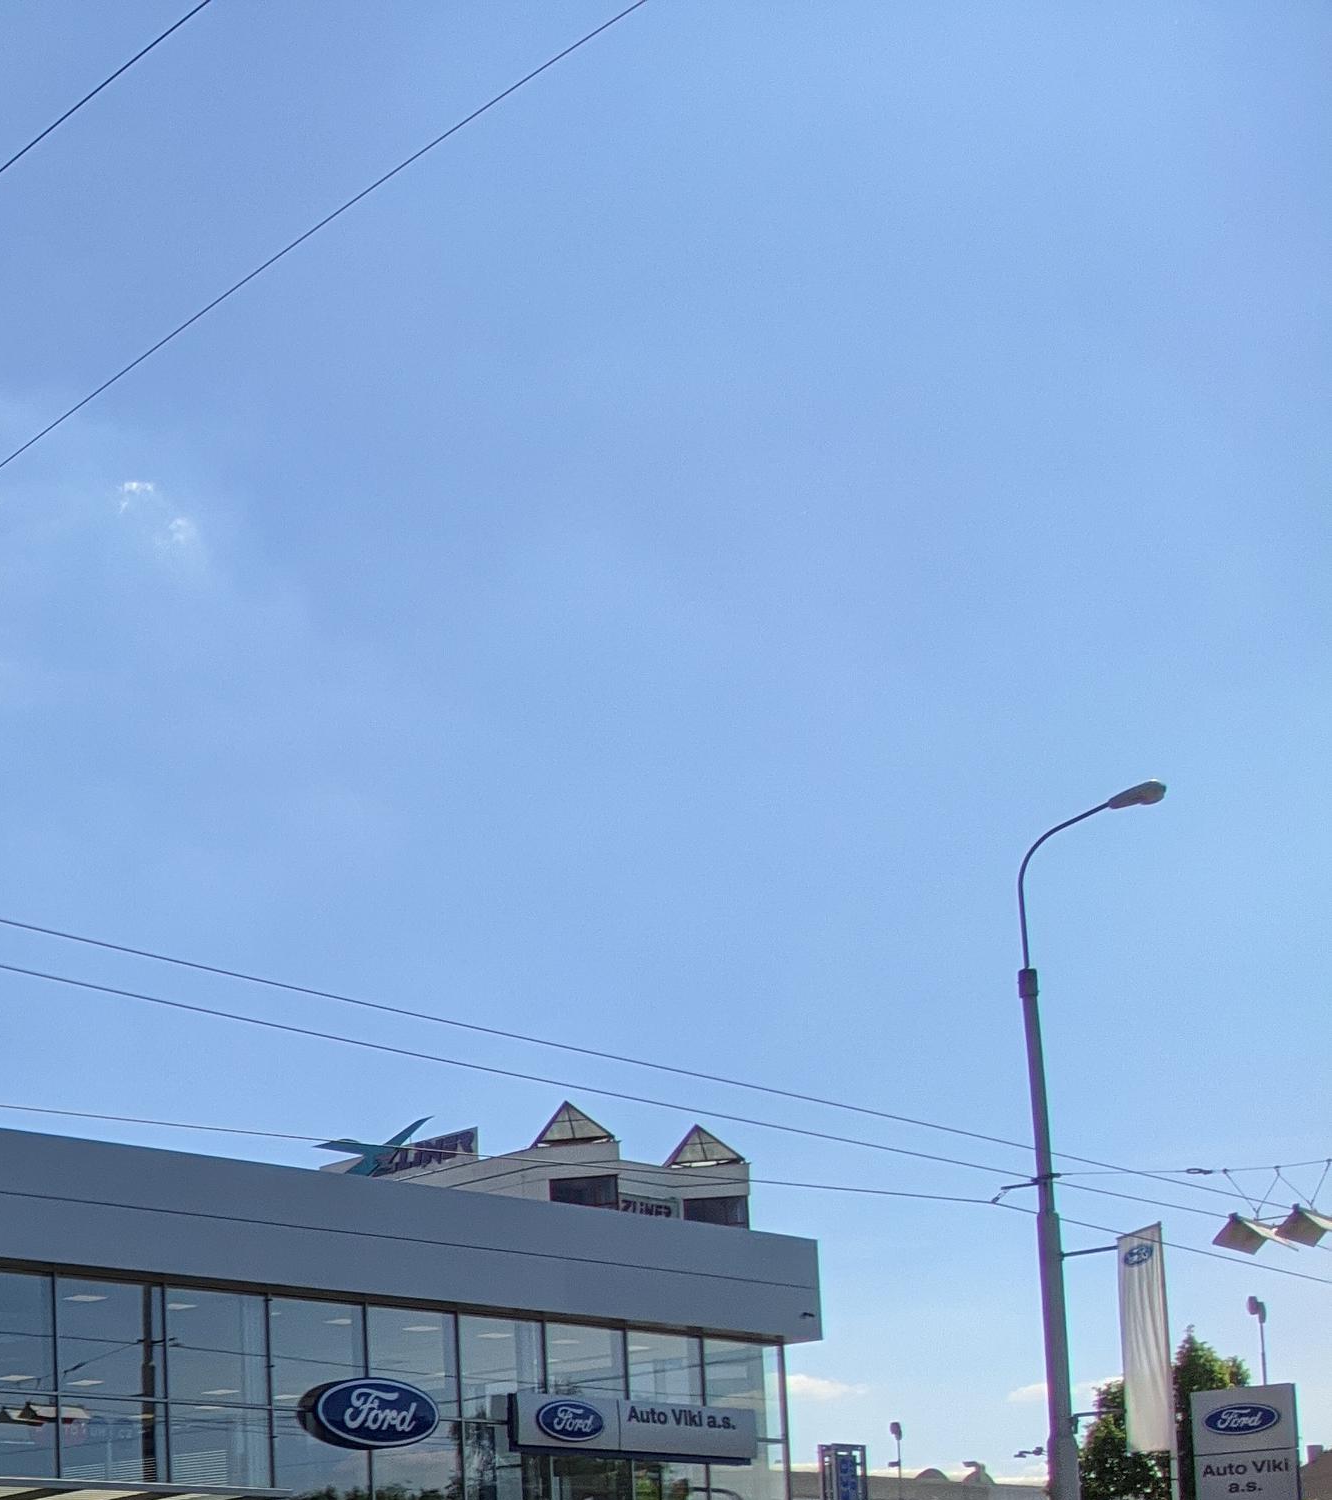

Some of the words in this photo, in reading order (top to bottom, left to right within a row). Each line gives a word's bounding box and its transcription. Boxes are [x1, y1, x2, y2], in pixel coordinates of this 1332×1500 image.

[344, 1387, 418, 1432] Ford
[553, 1406, 595, 1433] Ford
[627, 1405, 668, 1425] Auto
[671, 1408, 704, 1427] Viki
[707, 1414, 737, 1430] a.s.
[1216, 1408, 1263, 1430] Ford
[1203, 1463, 1248, 1478] Auto
[1251, 1458, 1290, 1473] Viki
[1228, 1481, 1264, 1494] a.s.
